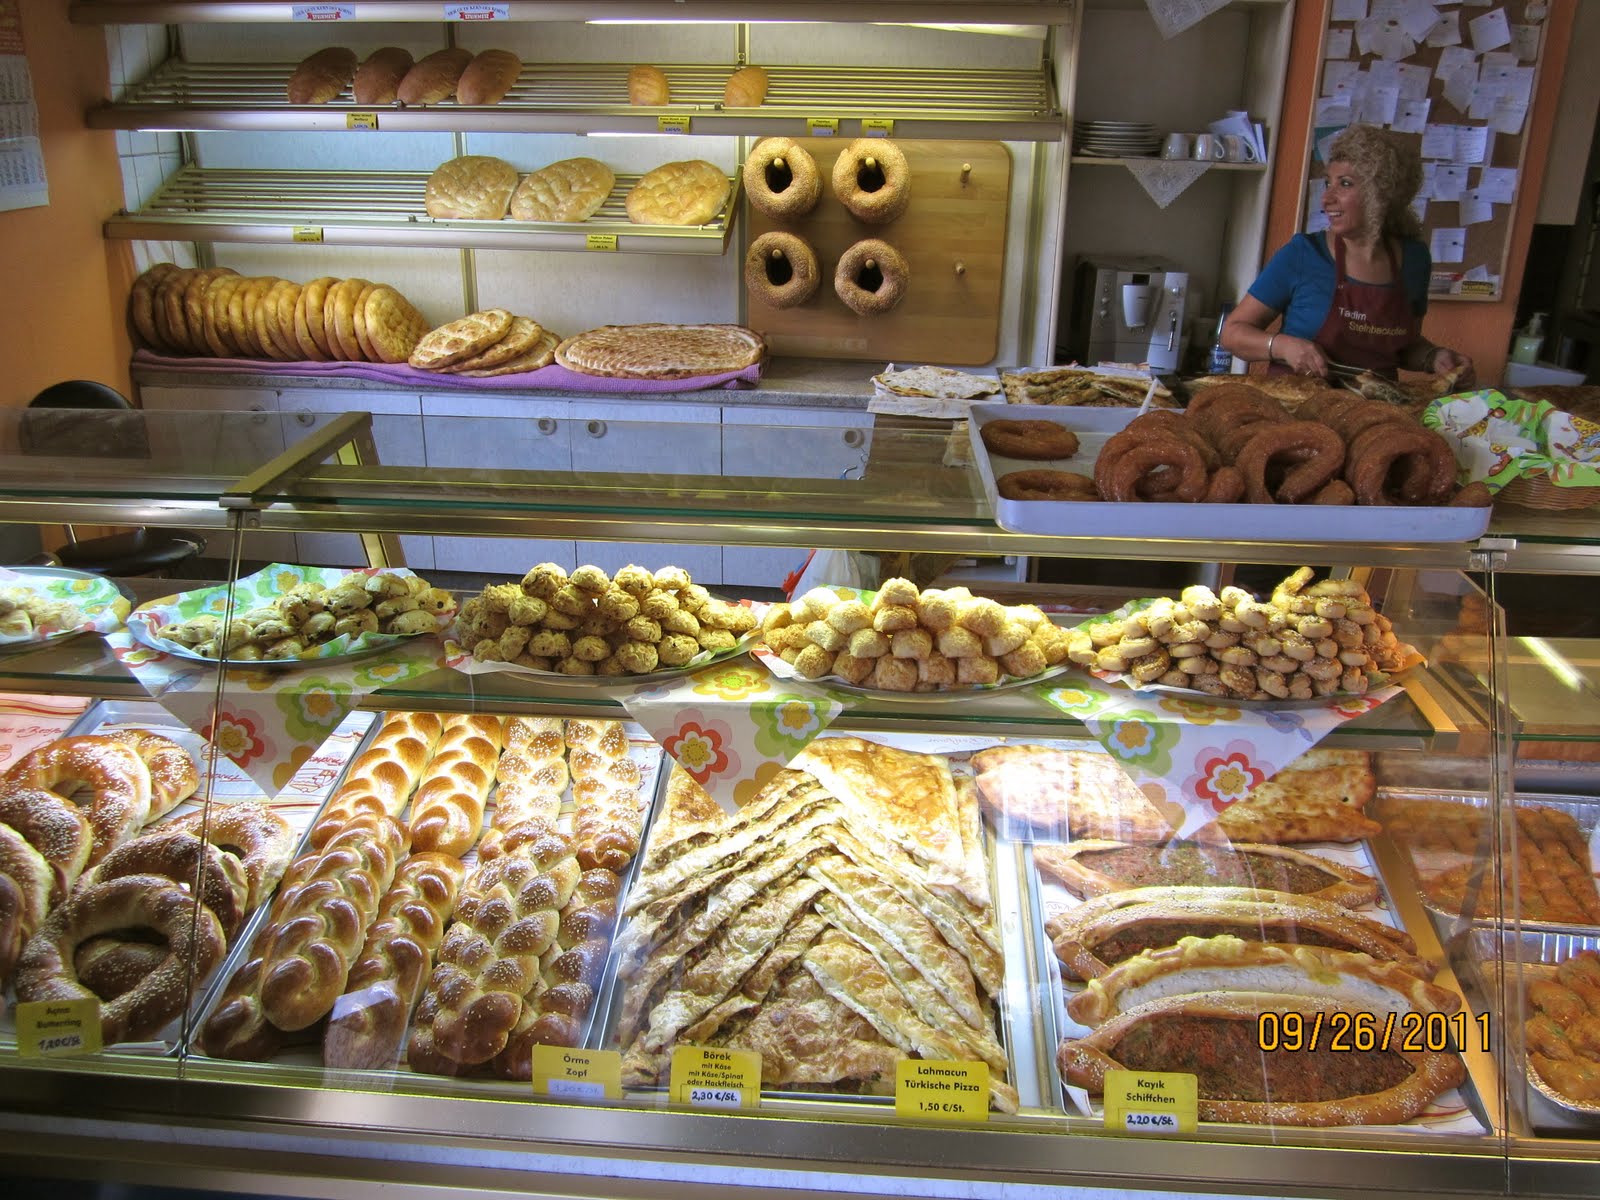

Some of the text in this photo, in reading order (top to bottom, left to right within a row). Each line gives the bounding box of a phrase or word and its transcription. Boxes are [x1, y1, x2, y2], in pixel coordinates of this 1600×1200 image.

[564, 1053, 590, 1064] Örme
[704, 1051, 731, 1060] Börek
[566, 1068, 587, 1077] Zopf
[918, 1067, 967, 1076] Lahmacun
[905, 1080, 979, 1091] Türkische Pizza
[1126, 1093, 1175, 1103] Schiffchen
[920, 1102, 965, 1112] 1,50 €/St.
